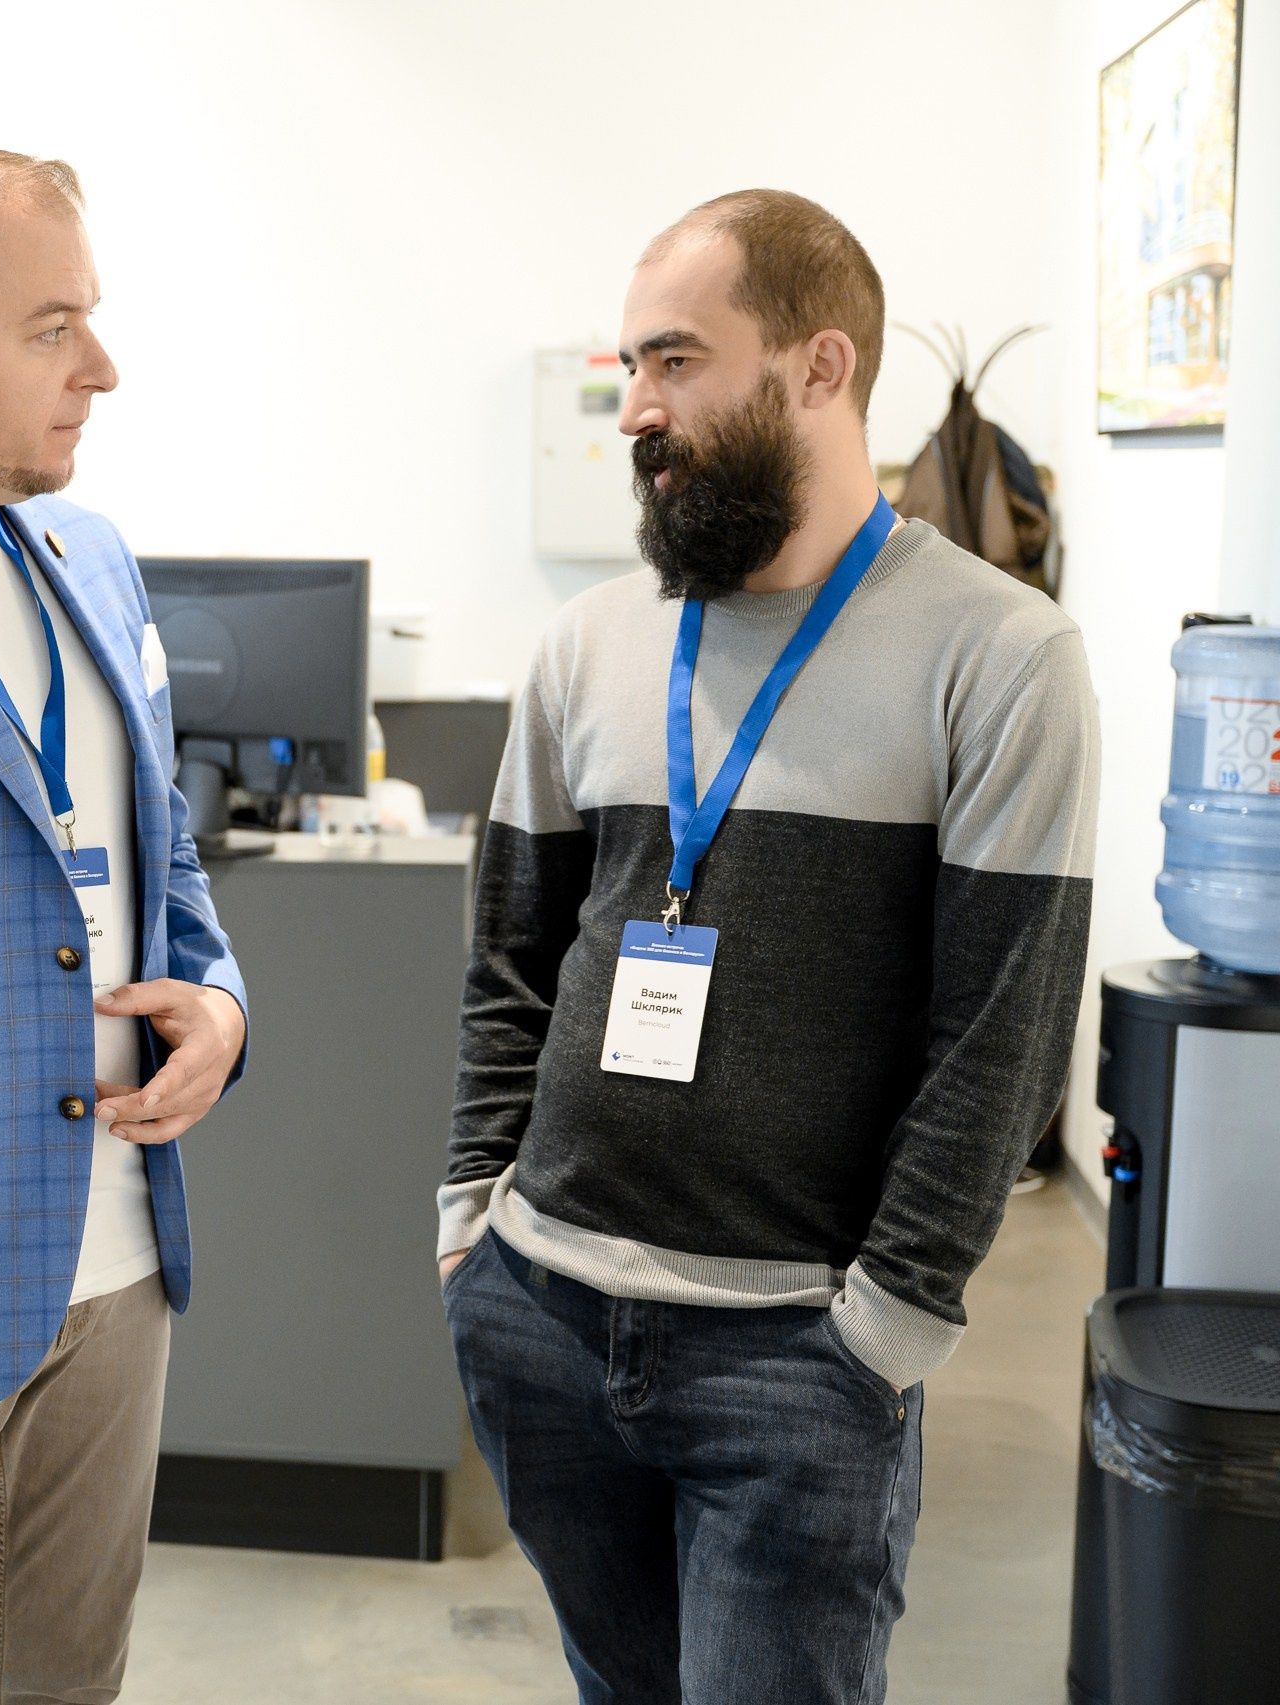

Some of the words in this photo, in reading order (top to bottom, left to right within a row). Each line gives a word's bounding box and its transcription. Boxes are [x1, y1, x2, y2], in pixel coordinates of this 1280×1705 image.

[89, 929, 103, 937] нко
[641, 988, 677, 1000] Вадим
[631, 1000, 683, 1015] Шклярик
